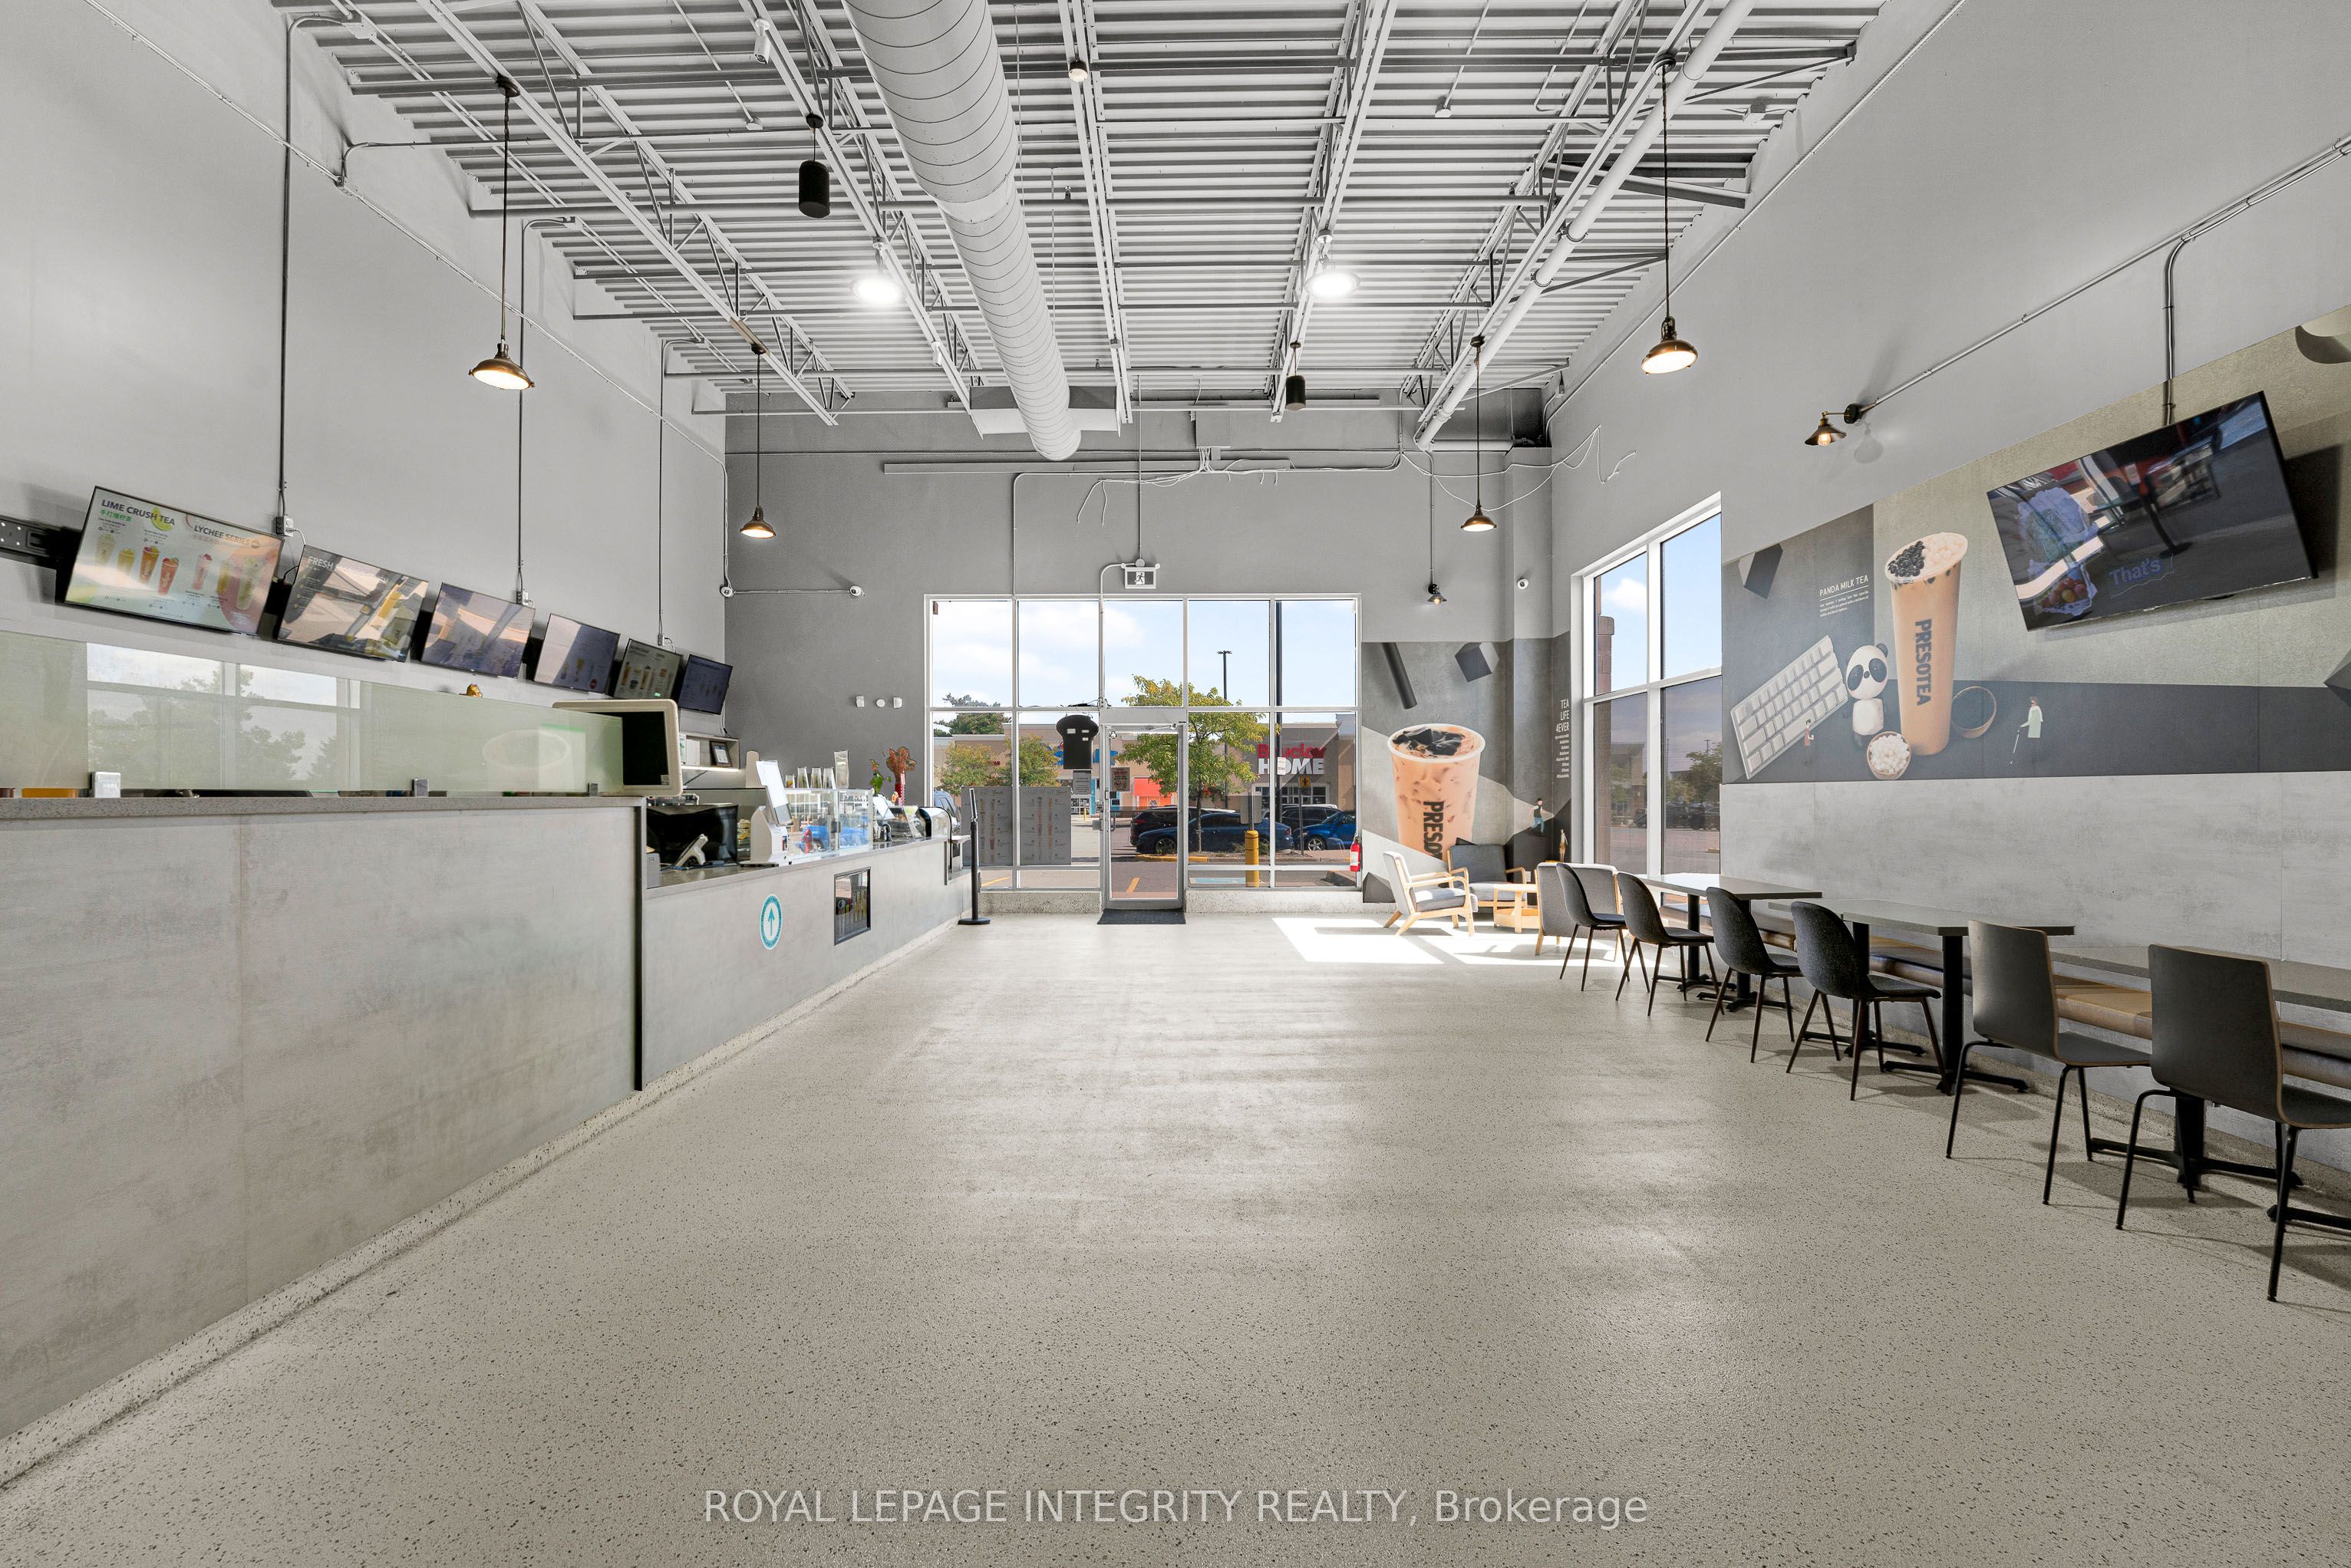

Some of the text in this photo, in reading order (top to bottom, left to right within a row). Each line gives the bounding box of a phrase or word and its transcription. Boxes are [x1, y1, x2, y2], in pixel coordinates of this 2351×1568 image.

[101, 499, 125, 512] LIME
[127, 506, 157, 521] CRUSH
[159, 515, 175, 525] TEA
[194, 525, 224, 539] LYCHEE
[225, 533, 250, 546] SERIES
[308, 555, 334, 572] FRESH
[2108, 557, 2161, 585] That's
[1819, 575, 1868, 597] PANDA MILK TEA
[1915, 618, 1932, 706] PRESOTEA
[1560, 699, 1570, 709] TEA
[1560, 710, 1570, 721] LIFE
[1555, 722, 1570, 733] 4EVER
